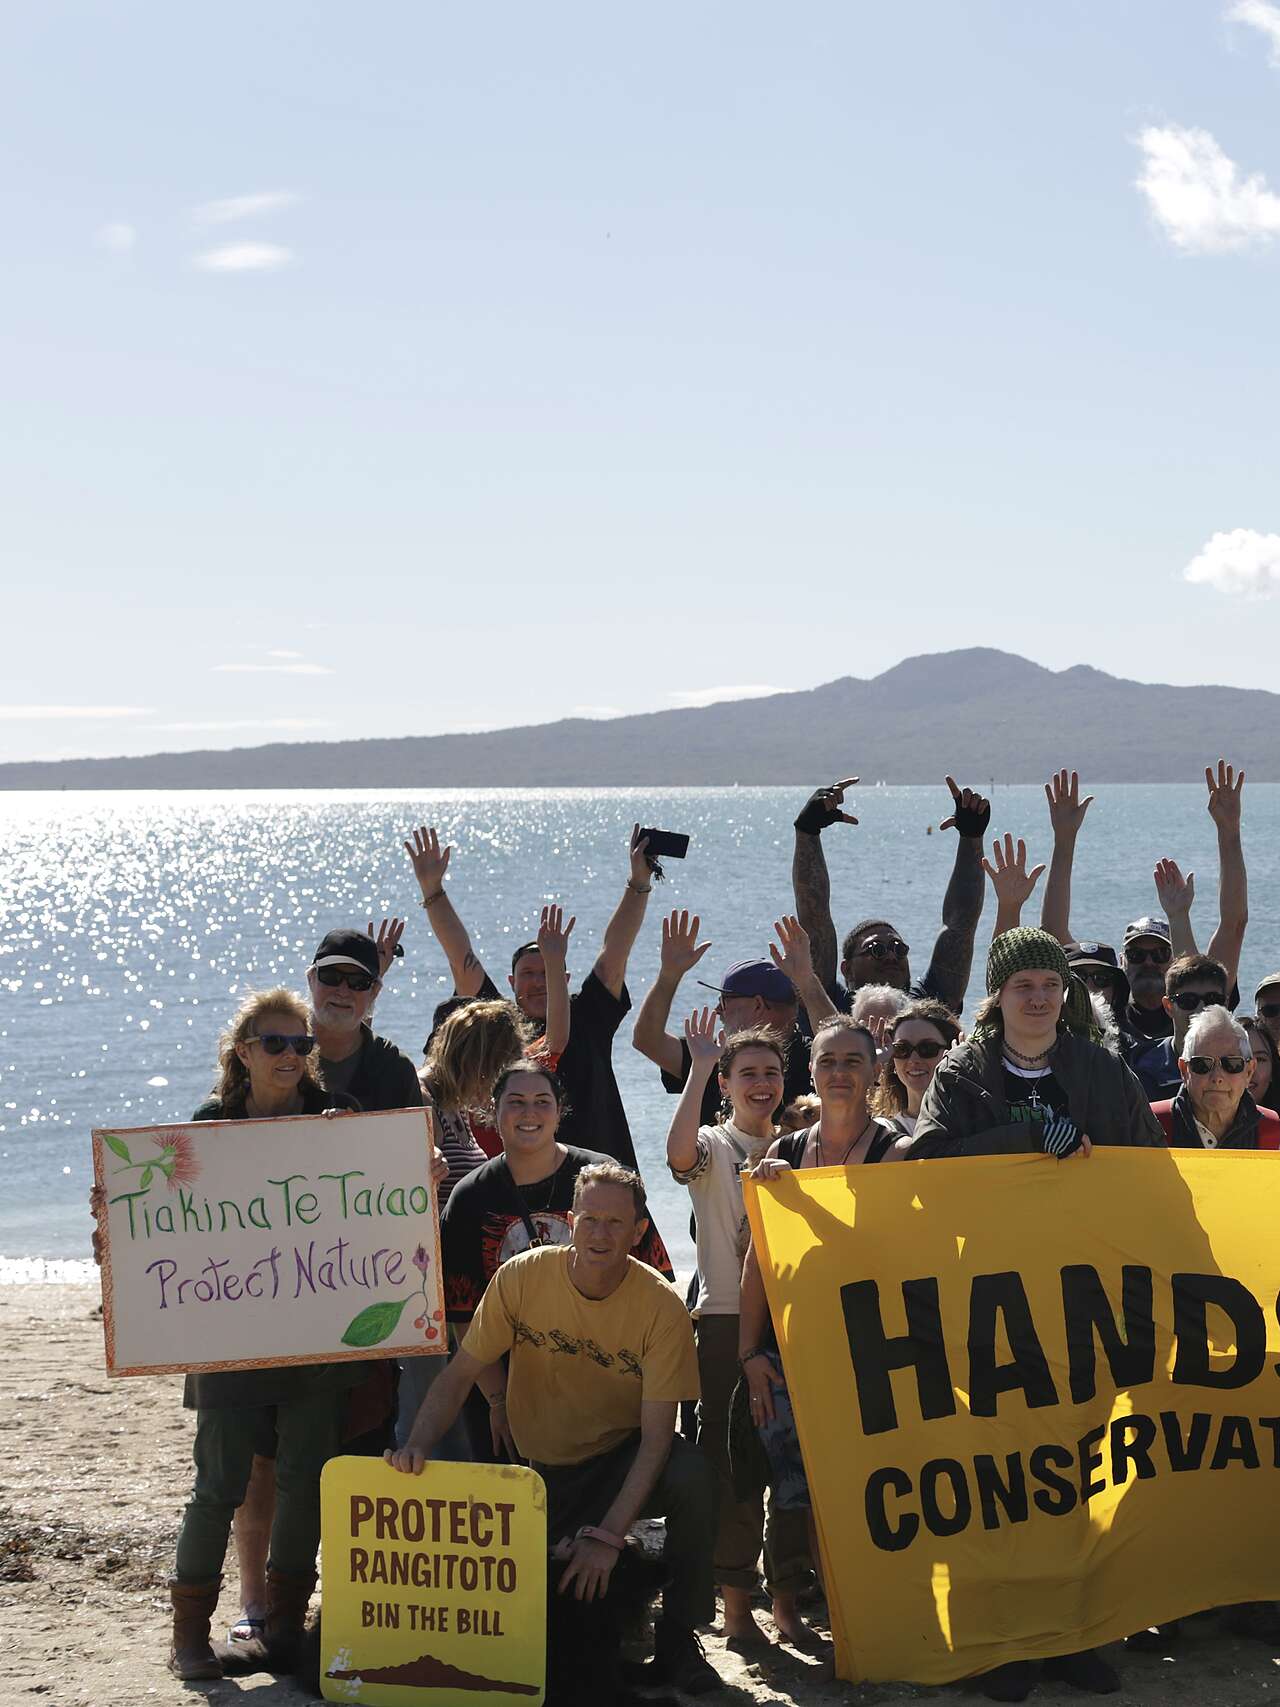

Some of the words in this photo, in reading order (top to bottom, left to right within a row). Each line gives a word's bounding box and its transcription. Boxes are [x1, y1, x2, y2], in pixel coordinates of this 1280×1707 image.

[109, 1188, 272, 1240] Tiakina
[267, 1175, 321, 1226] Te
[318, 1171, 429, 1219] Taiao
[145, 1246, 282, 1309] Protect
[293, 1236, 407, 1299] Nature
[350, 1495, 516, 1547] PROTECT
[350, 1547, 517, 1594] RANGITOTO
[361, 1600, 401, 1630] BIN
[406, 1604, 449, 1633] THE
[456, 1607, 505, 1637] BILL
